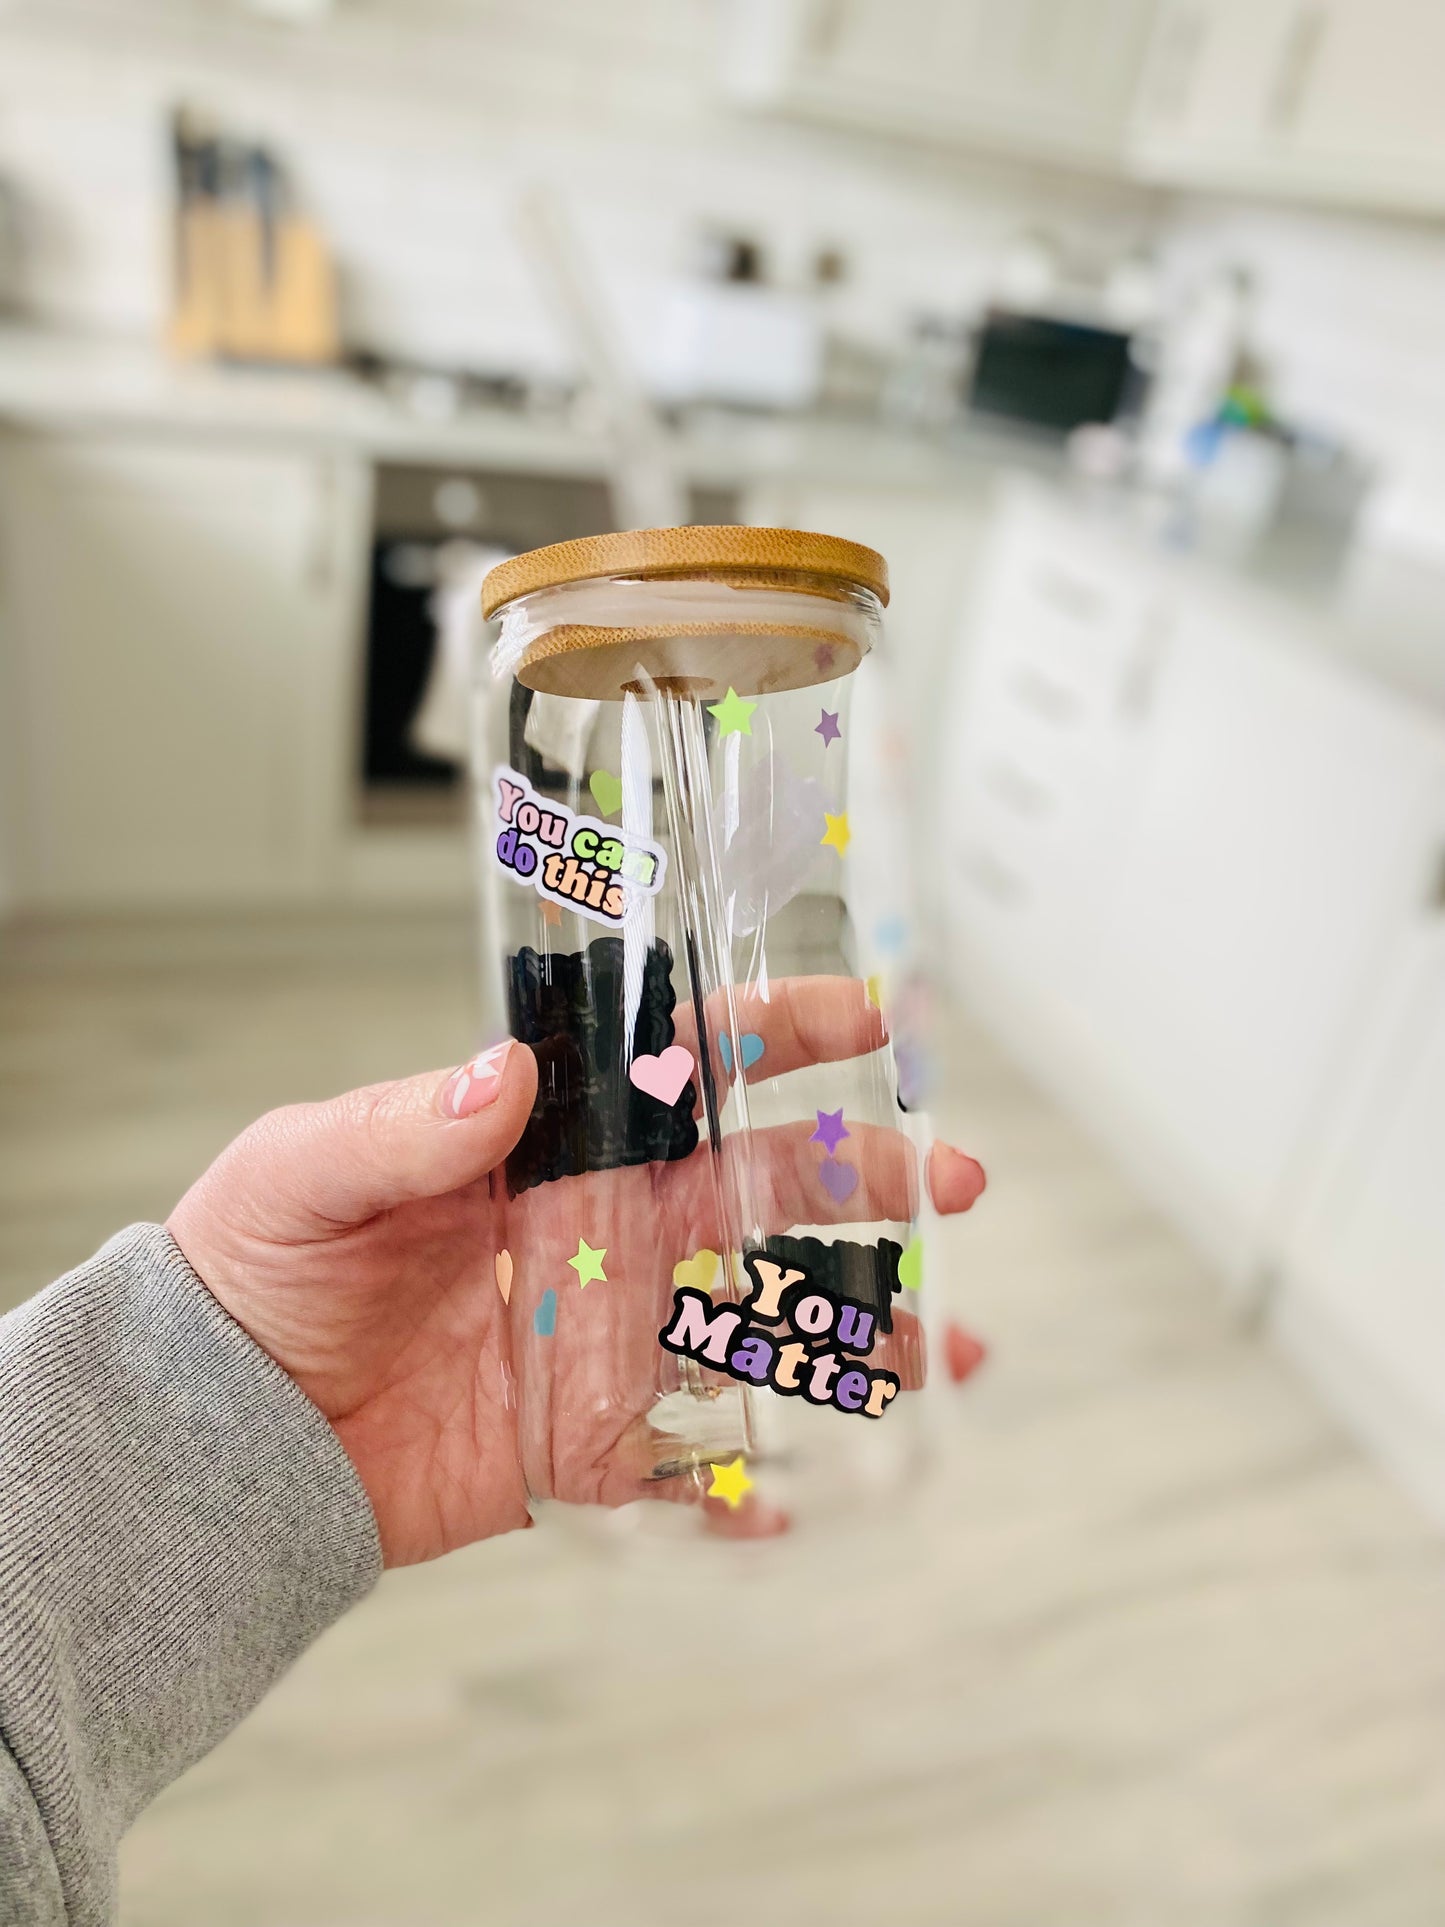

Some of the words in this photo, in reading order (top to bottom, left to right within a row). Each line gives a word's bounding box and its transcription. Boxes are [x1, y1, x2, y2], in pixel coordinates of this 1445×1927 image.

[496, 777, 567, 847] You
[573, 828, 657, 887] can
[496, 828, 537, 877] do
[543, 852, 628, 919] this
[750, 1257, 874, 1350] You
[666, 1295, 898, 1417] Matter
